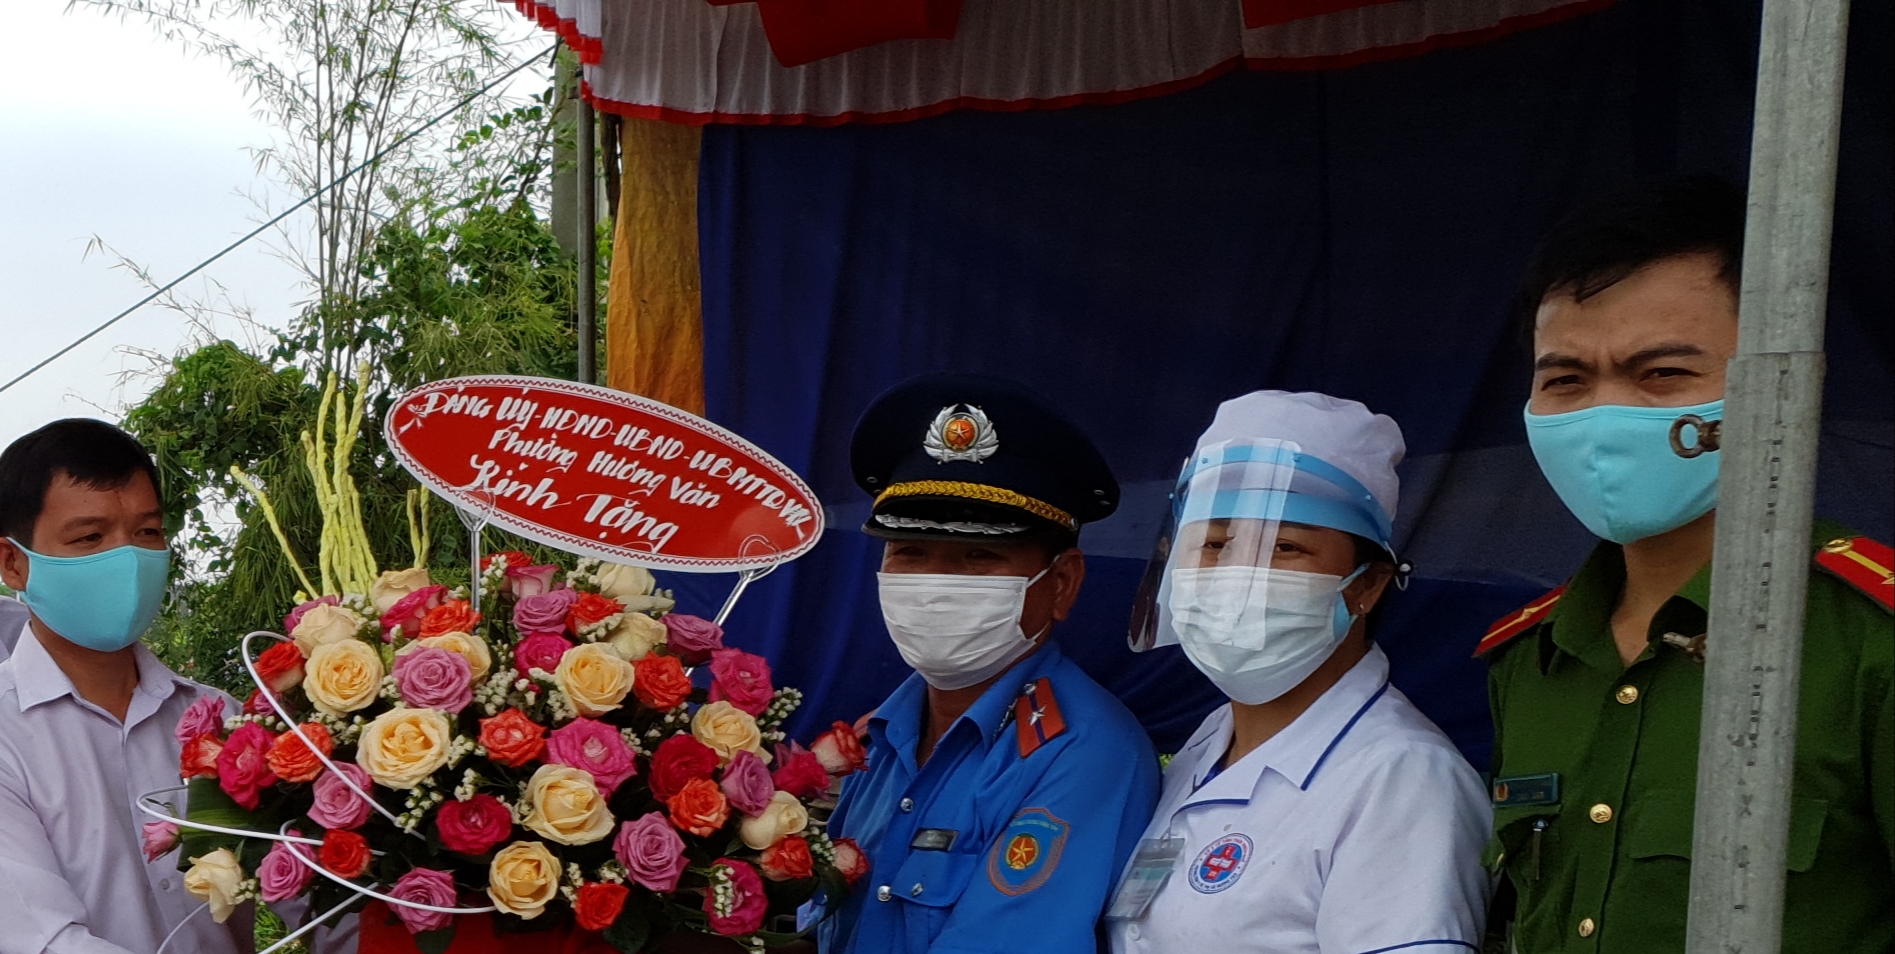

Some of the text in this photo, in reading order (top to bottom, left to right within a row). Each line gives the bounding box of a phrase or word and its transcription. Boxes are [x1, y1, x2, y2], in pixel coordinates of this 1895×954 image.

[462, 453, 680, 555] Kính Tặng
[669, 475, 721, 509] Văn
